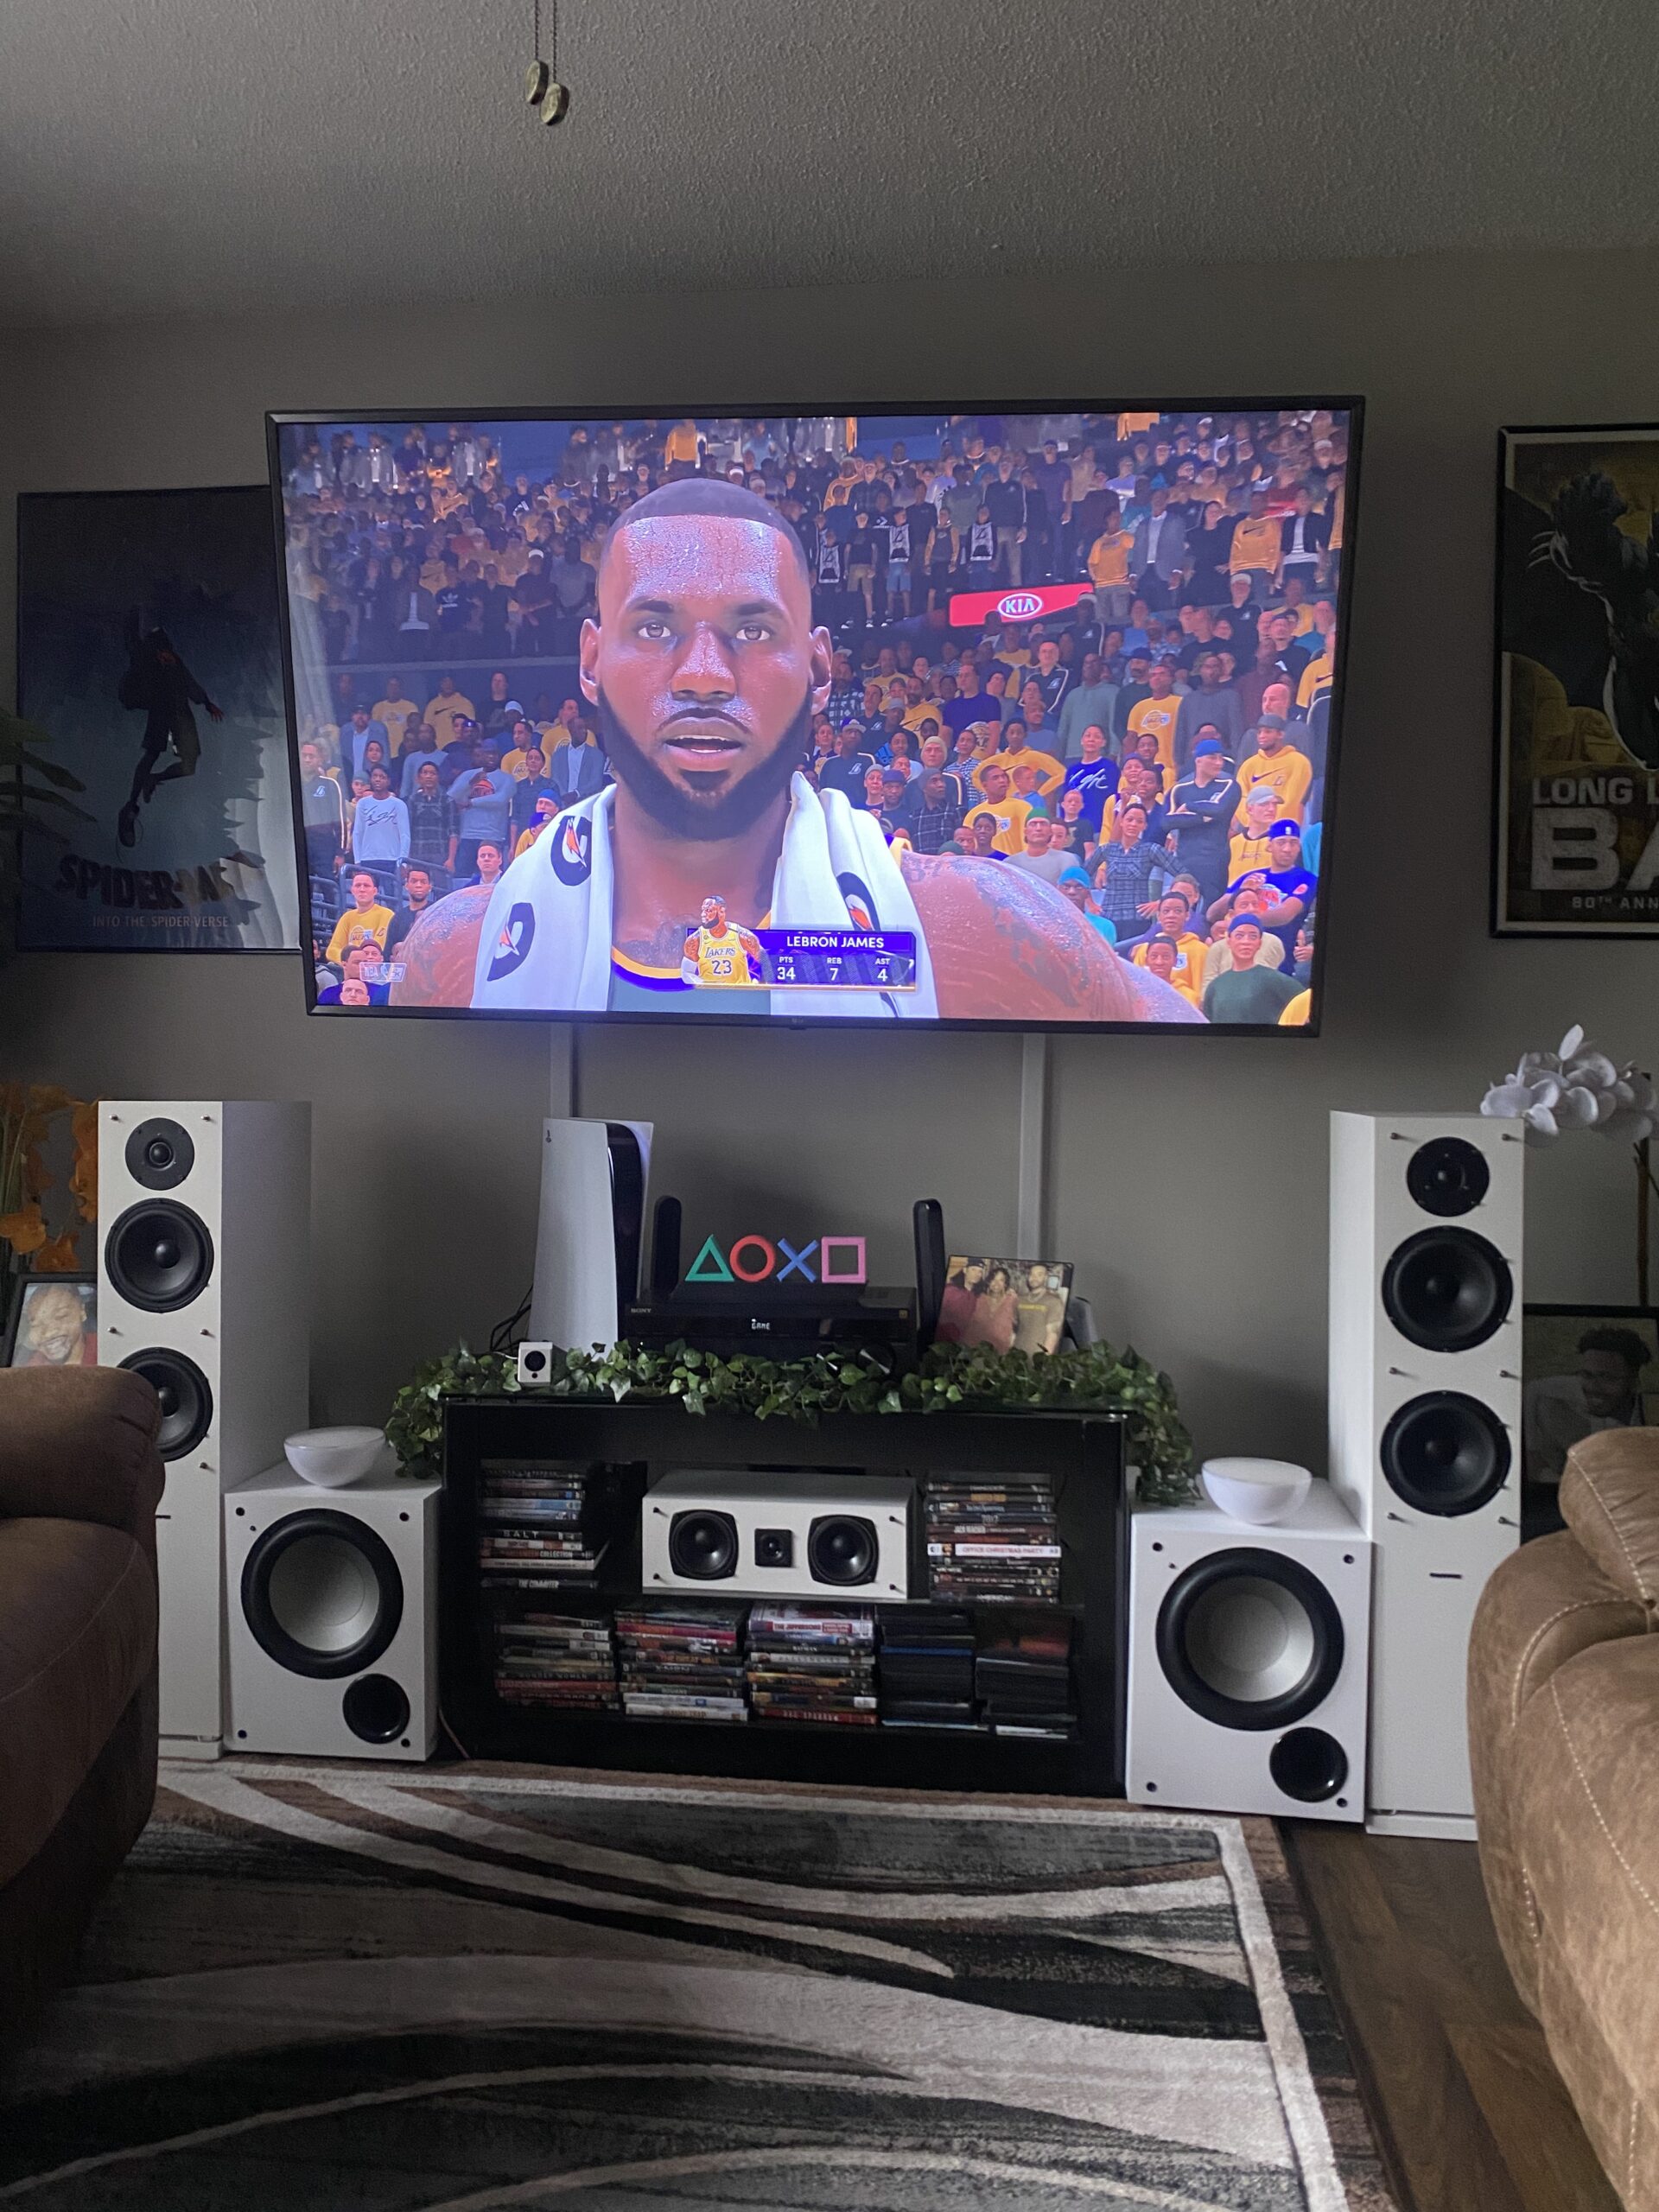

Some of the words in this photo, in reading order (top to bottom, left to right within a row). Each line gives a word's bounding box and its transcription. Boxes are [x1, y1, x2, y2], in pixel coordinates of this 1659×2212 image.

[1005, 598, 1035, 613] KIA
[1532, 777, 1634, 804] LONG
[93, 915, 121, 927] INTO
[124, 915, 145, 927] THE
[786, 936, 838, 948] LEBRON
[841, 937, 885, 949] JAMES
[704, 946, 736, 958] LAKERS
[364, 966, 379, 977] NBA
[711, 959, 732, 975] 23
[777, 966, 796, 980] 34
[830, 968, 839, 981] 7
[876, 968, 888, 982] 4
